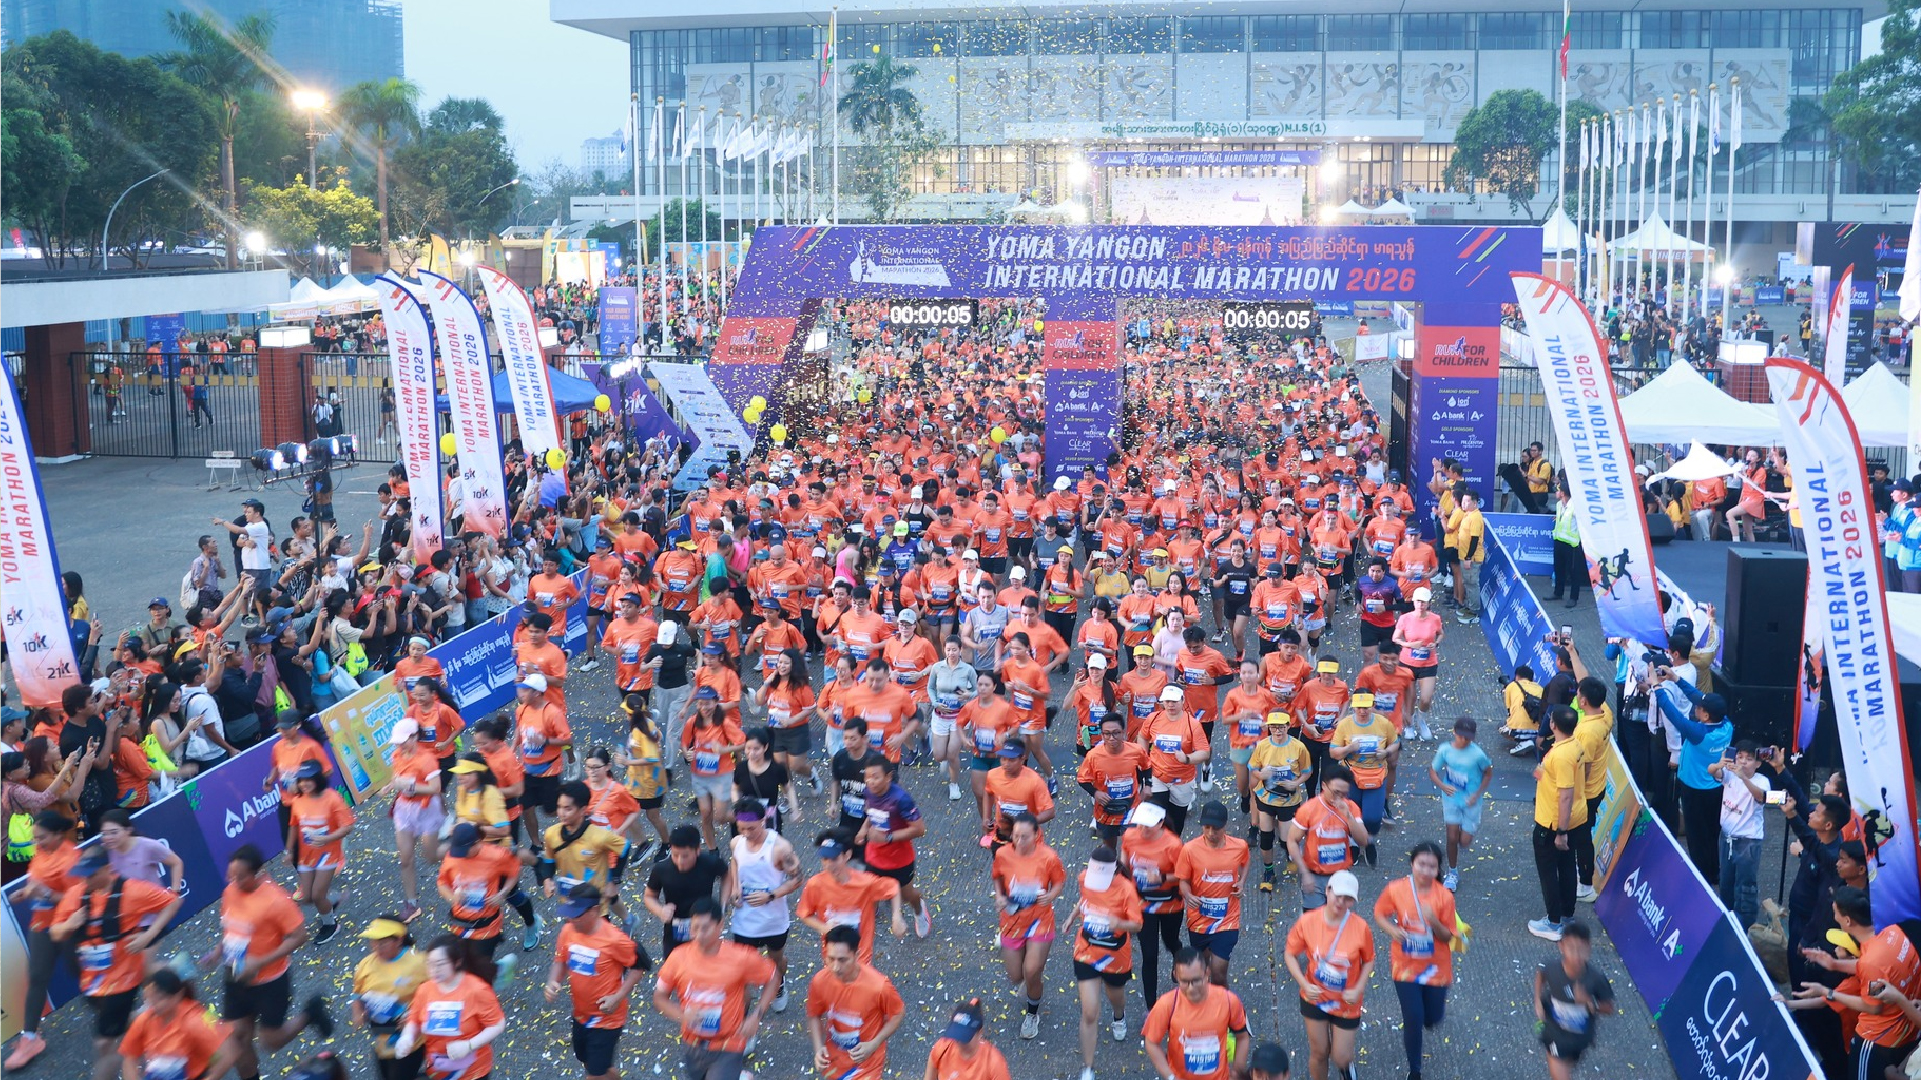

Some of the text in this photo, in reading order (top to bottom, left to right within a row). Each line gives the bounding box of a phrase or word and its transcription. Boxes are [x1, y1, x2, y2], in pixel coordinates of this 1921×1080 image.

[1224, 153, 1258, 163] MARATHON
[985, 236, 1167, 260] YOMA YANGON
[984, 266, 1417, 292] INTERNATIONAL MARATHON 2026
[889, 304, 972, 325] 00:00:05
[1223, 309, 1310, 330] 00:00:05
[1052, 350, 1106, 360] CHILDREN
[1434, 343, 1486, 356] RUN FOR
[500, 306, 537, 432] YOMA INTERNATIONAL
[521, 321, 548, 418] MARATHON 2026
[1432, 357, 1489, 367] CHILDREN
[447, 316, 476, 453] YOMA INTERNATIONAL
[466, 333, 491, 439] MARATHON 2026
[412, 346, 431, 462] MARATHON 2026
[1441, 411, 1447, 419] A
[1448, 411, 1465, 419] bank
[1545, 334, 1608, 526] YOMA INTERNATIONAL
[1573, 354, 1621, 497] MARATHON 2026
[409, 443, 421, 479] YOMA
[1444, 449, 1469, 458] CLEAR
[464, 469, 476, 480] 5K
[1, 451, 38, 557] MARATHON
[473, 489, 488, 499] 10K
[486, 508, 502, 518] 21K
[1836, 490, 1864, 560] 2026
[1, 530, 21, 583] YOMA
[1804, 460, 1858, 680] INTERNATIONAL
[6, 608, 23, 627] 5K
[22, 634, 48, 653] 10K
[1848, 570, 1885, 717] MARATHON
[47, 662, 71, 679] 21K
[242, 800, 257, 822] A
[1634, 880, 1649, 904] A
[1641, 887, 1665, 932] bank
